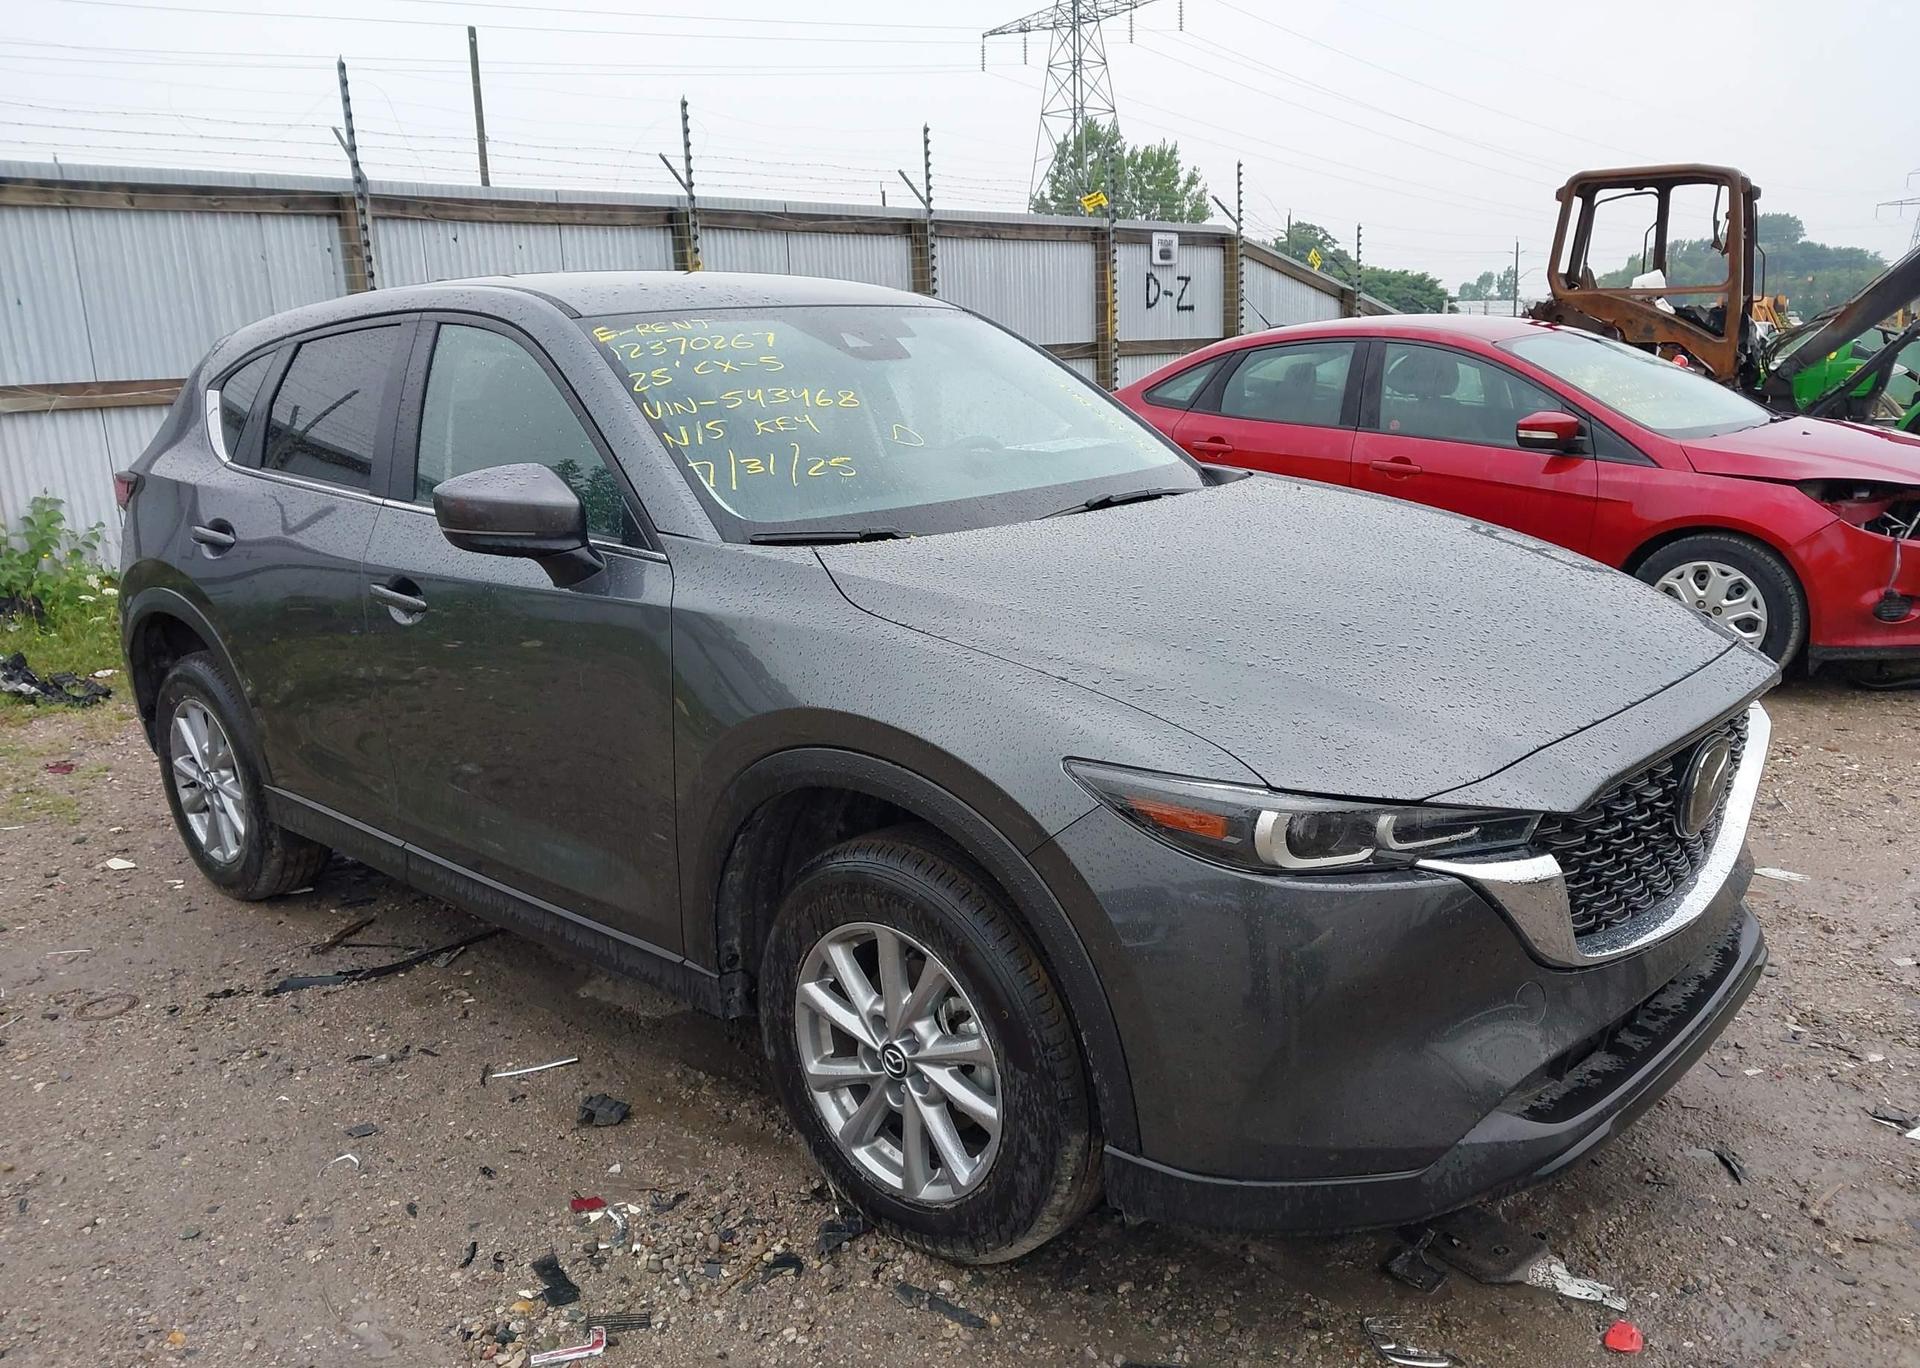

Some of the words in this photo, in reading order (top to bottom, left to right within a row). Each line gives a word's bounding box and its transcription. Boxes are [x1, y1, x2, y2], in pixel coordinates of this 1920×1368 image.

[1146, 272, 1194, 311] D-Z
[593, 319, 713, 341] E-RENT
[610, 332, 775, 360] 12370267
[693, 356, 785, 374] CX-5
[754, 414, 820, 436] KEY
[688, 443, 857, 490] 7/31/25
